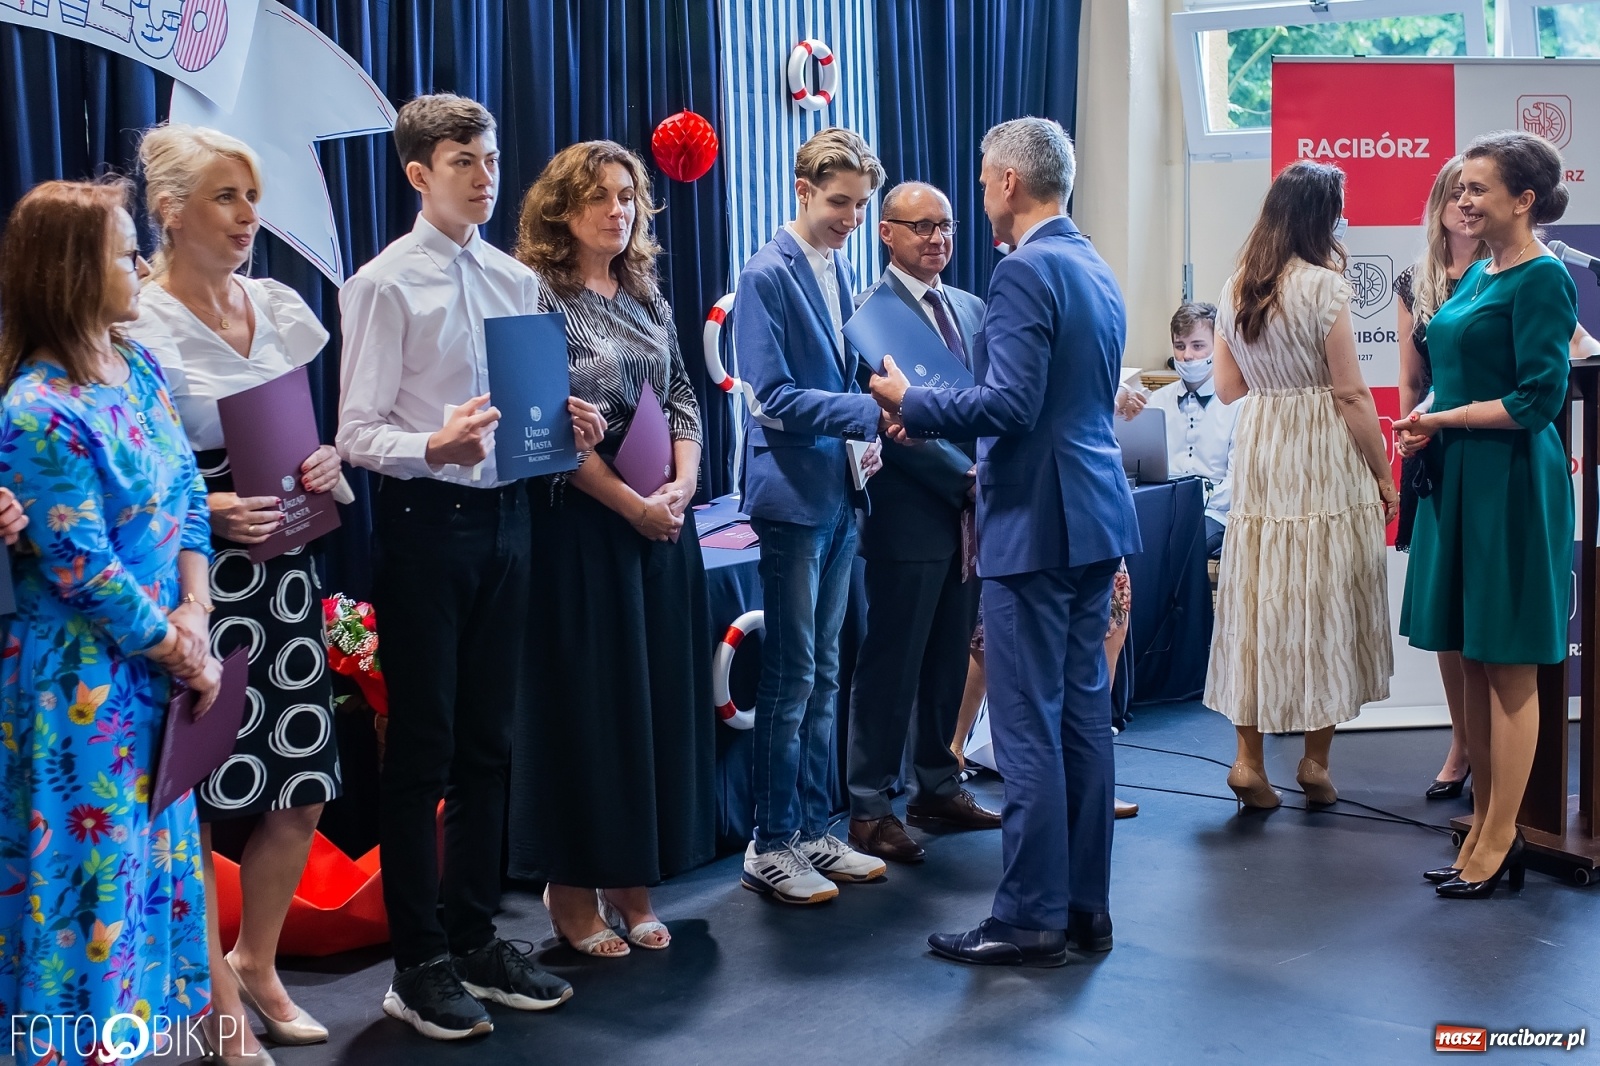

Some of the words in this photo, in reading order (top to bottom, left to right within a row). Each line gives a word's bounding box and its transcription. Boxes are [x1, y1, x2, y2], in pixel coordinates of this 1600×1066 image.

[1297, 132, 1430, 158] RACIBÓRZ
[1354, 327, 1399, 343] IBÓR
[524, 439, 552, 451] MIASTA
